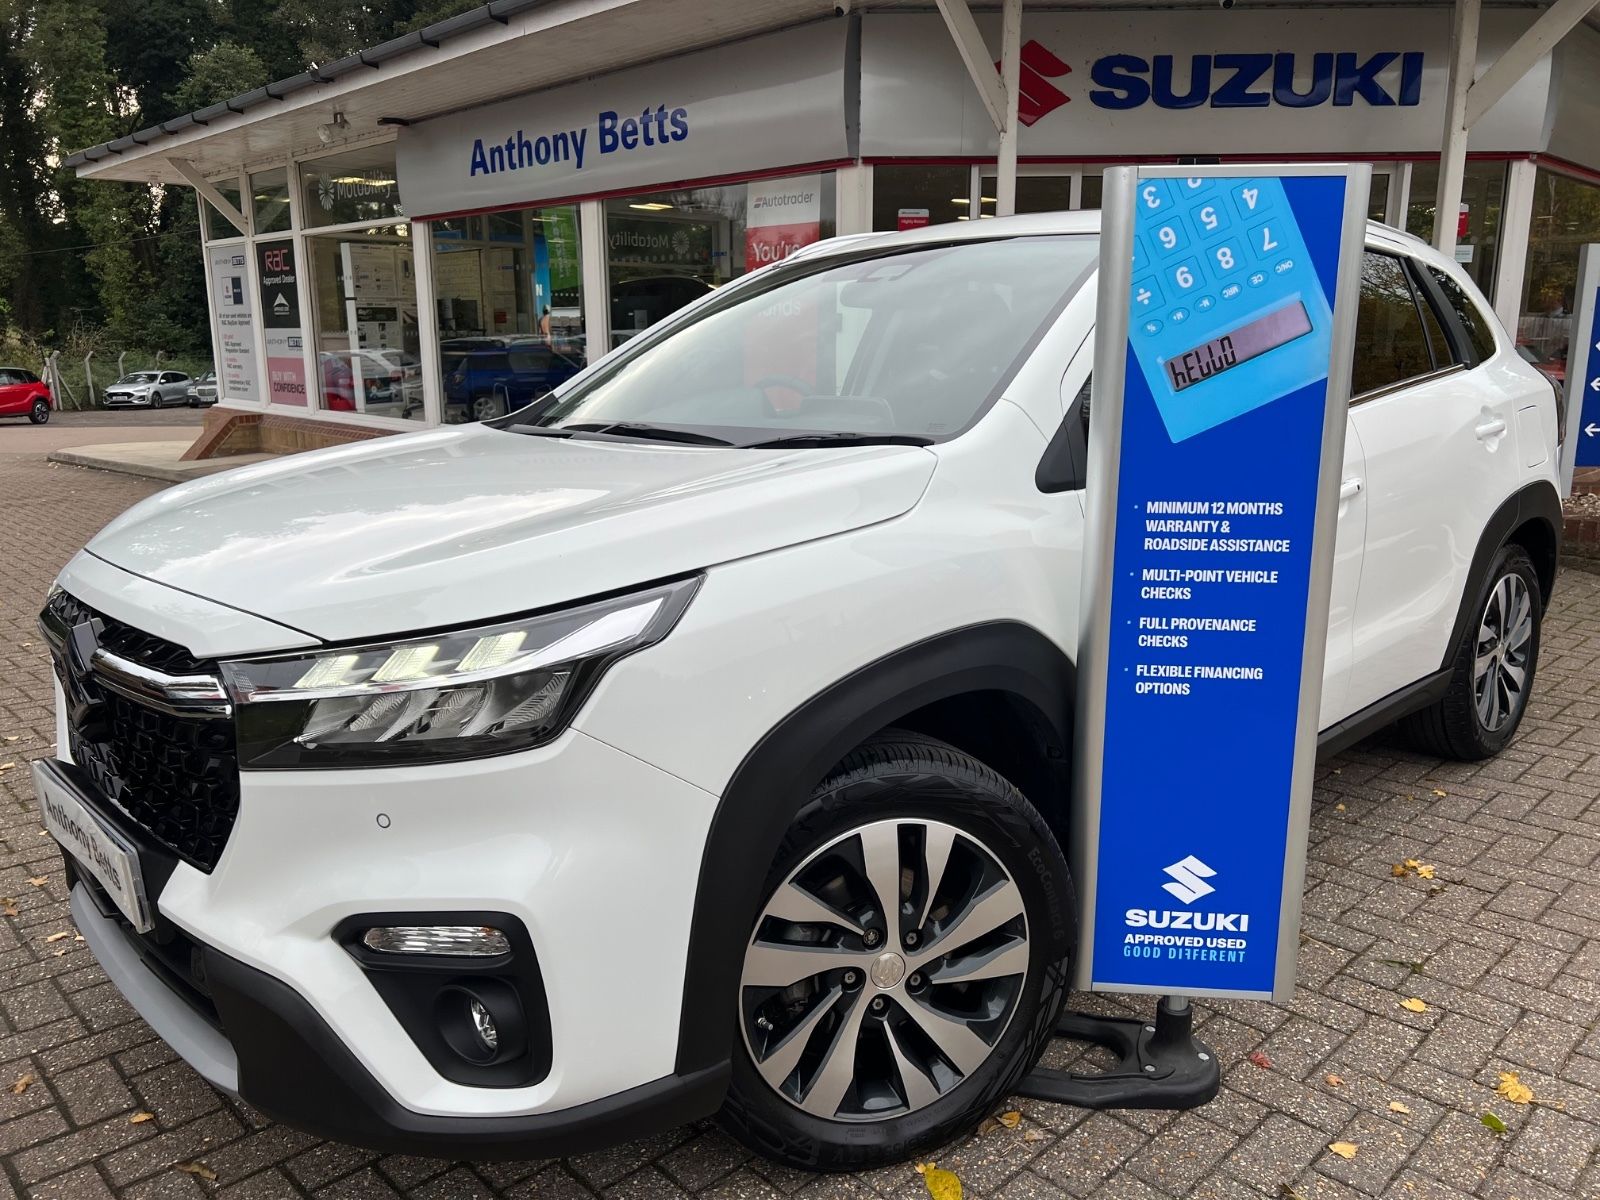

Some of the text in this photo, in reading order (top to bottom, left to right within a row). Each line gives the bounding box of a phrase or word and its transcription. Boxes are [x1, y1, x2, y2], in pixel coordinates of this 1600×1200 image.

[1089, 52, 1424, 109] SUZUKI
[470, 104, 688, 176] Anthony Betts
[762, 193, 813, 208] Autotrader
[1143, 186, 1161, 208] 3
[1200, 188, 1259, 231] 5 4
[1262, 227, 1278, 251] 7
[1216, 247, 1235, 270] 8
[274, 382, 305, 394] CONFIDENCE
[1147, 501, 1283, 515] MINIMUM 12 MONTHS
[1146, 520, 1230, 533] WARRANTY &
[1144, 538, 1290, 552] ROADSIDE ASSISTANCE
[1142, 569, 1278, 583] MULTI-POINT VEHICLE
[1141, 587, 1191, 599] CHECKS
[1139, 617, 1256, 631] FULL PROVENANCE
[1138, 635, 1188, 647] CHECKS
[1136, 665, 1263, 680] FLEXIBLE FINANCING
[1135, 682, 1190, 695] OPTIONS
[44, 792, 122, 891] Anthony Betts
[1125, 909, 1249, 932] SUZUKI
[1124, 933, 1247, 949] APPROVED USED
[1124, 945, 1245, 963] GOOD DIFFERENT
